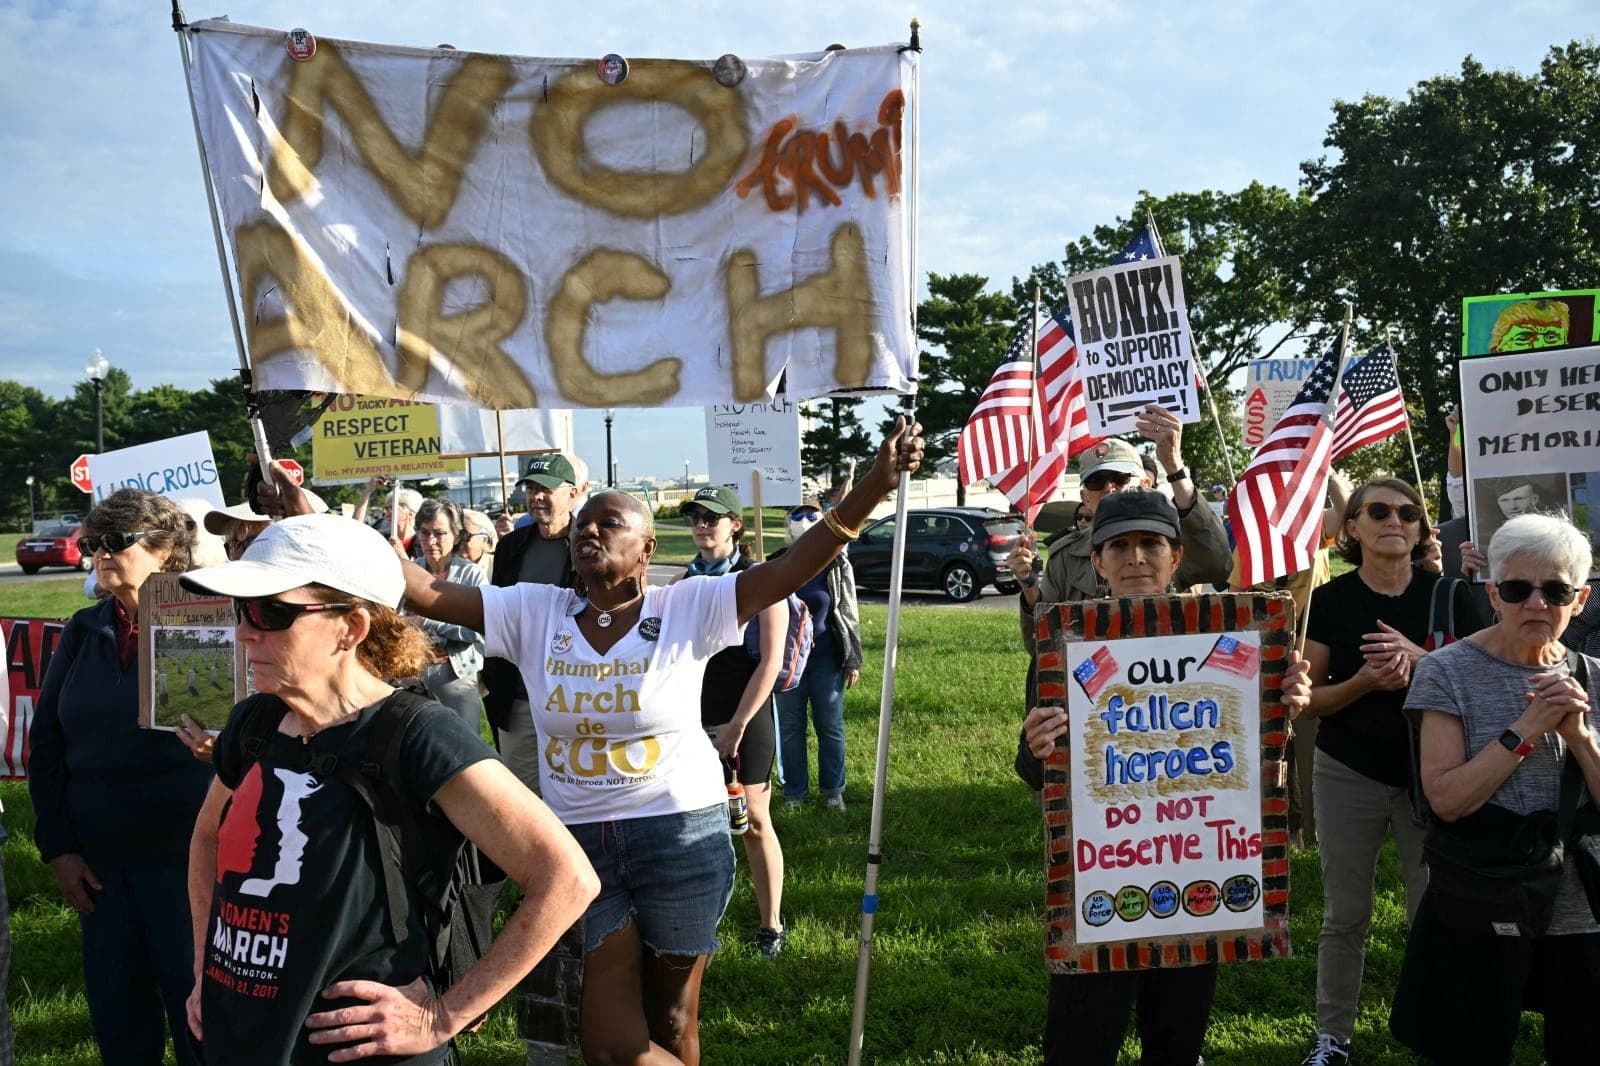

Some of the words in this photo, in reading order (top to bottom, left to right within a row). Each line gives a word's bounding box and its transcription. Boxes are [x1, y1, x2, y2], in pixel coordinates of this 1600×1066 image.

[264, 44, 752, 228] NO
[236, 221, 876, 409] ARCH
[1072, 264, 1180, 344] HONK!
[1086, 350, 1100, 365] to
[1104, 331, 1182, 367] SUPPORT
[1087, 360, 1189, 401] DEMOCRACY
[1479, 368, 1548, 394] ONLY
[1560, 363, 1600, 388] HE
[357, 399, 388, 410] TACKY
[324, 415, 408, 437] RESPECT
[354, 437, 440, 459] VETERAN
[342, 467, 354, 475] MY
[355, 464, 392, 474] PARENTS
[401, 461, 444, 472] RELATIVES
[1127, 656, 1196, 685] our
[545, 683, 641, 714] Arch
[576, 718, 606, 735] de
[1100, 694, 1218, 734] fallen
[545, 736, 661, 777] EGO
[1105, 740, 1234, 785] heroes
[575, 777, 603, 786] heroes
[606, 777, 626, 786] NOT
[1105, 804, 1141, 829] DO
[1156, 796, 1214, 823] NOT
[1076, 832, 1203, 872] Deserve
[1204, 819, 1262, 862] This
[1123, 891, 1137, 899] US
[1158, 885, 1171, 895] US
[1197, 884, 1211, 893] US
[1088, 908, 1112, 918] Force
[1090, 902, 1104, 910] Air
[1120, 901, 1144, 911] Army
[213, 916, 289, 968] MARCH
[253, 983, 279, 998] 2017
